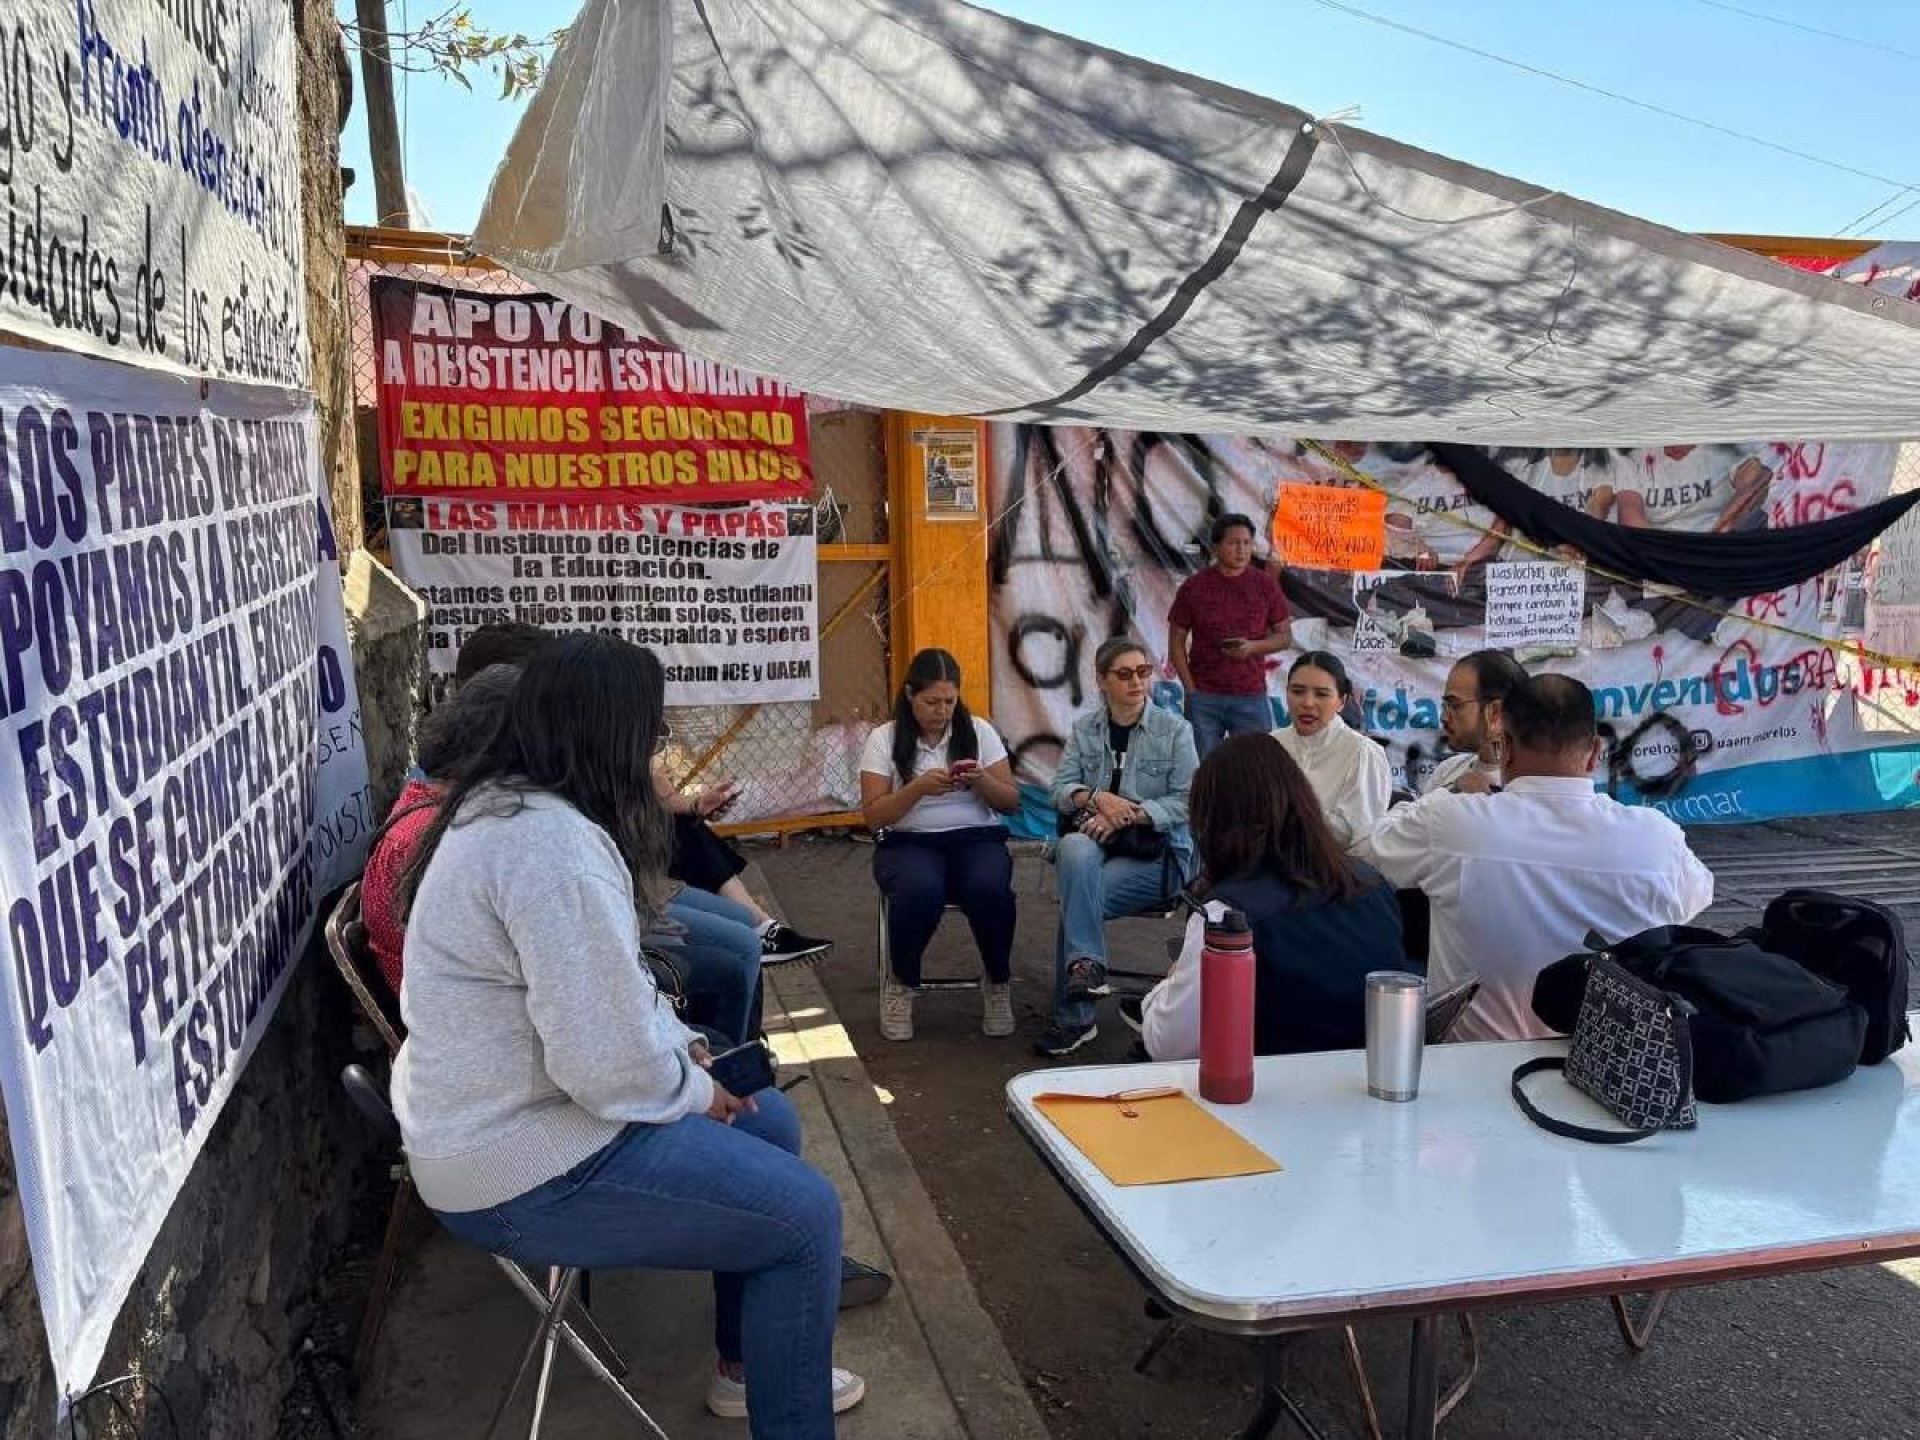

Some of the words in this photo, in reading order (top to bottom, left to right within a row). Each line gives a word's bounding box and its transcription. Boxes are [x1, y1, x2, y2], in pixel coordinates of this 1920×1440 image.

[51, 44, 73, 173] y
[0, 184, 121, 345] idades
[135, 204, 167, 352] de
[181, 224, 211, 371] los
[411, 291, 602, 344] APOYO
[384, 339, 407, 385] A
[402, 401, 591, 443] EXIGIMOS
[600, 406, 796, 446] SEGURIDAD
[87, 410, 216, 535] PADRES
[212, 414, 247, 513] DE
[394, 449, 498, 487] PARA
[504, 449, 699, 489] NUESTROS
[706, 448, 801, 483] HIJOS
[1646, 478, 1713, 508] UAEM
[427, 503, 497, 531] LAS
[653, 508, 672, 534] Y
[682, 500, 788, 538] PAPÁS
[422, 533, 467, 555] Del
[474, 532, 592, 555] Instituto
[598, 533, 630, 555] de
[636, 534, 747, 560] Ciencias
[751, 539, 781, 560] de
[512, 556, 544, 578] la
[551, 556, 713, 580] Educación.
[418, 585, 504, 605] stamos
[509, 586, 539, 604] en
[543, 583, 565, 603] el
[570, 583, 699, 604] movimiento
[704, 583, 812, 604] estudiantil
[514, 603, 574, 626] hijos
[578, 606, 606, 623] no
[611, 601, 672, 623] están
[676, 603, 737, 625] solos,
[741, 604, 804, 623] tienen
[0, 530, 193, 722] POYAMOS
[192, 523, 230, 622] LA
[627, 625, 721, 647] respalda
[725, 629, 738, 646] y
[743, 626, 811, 645] espera
[722, 663, 750, 682] ICE
[753, 665, 763, 682] y
[767, 660, 812, 681] UAEM
[1633, 742, 1680, 757] orelos
[9, 841, 109, 1055] QUE
[108, 796, 161, 940] SE
[162, 708, 275, 886] CUMPLA
[125, 806, 273, 1069] PETITORIO
[271, 775, 301, 873] DE
[172, 840, 314, 1139] ESTUDIANTES
